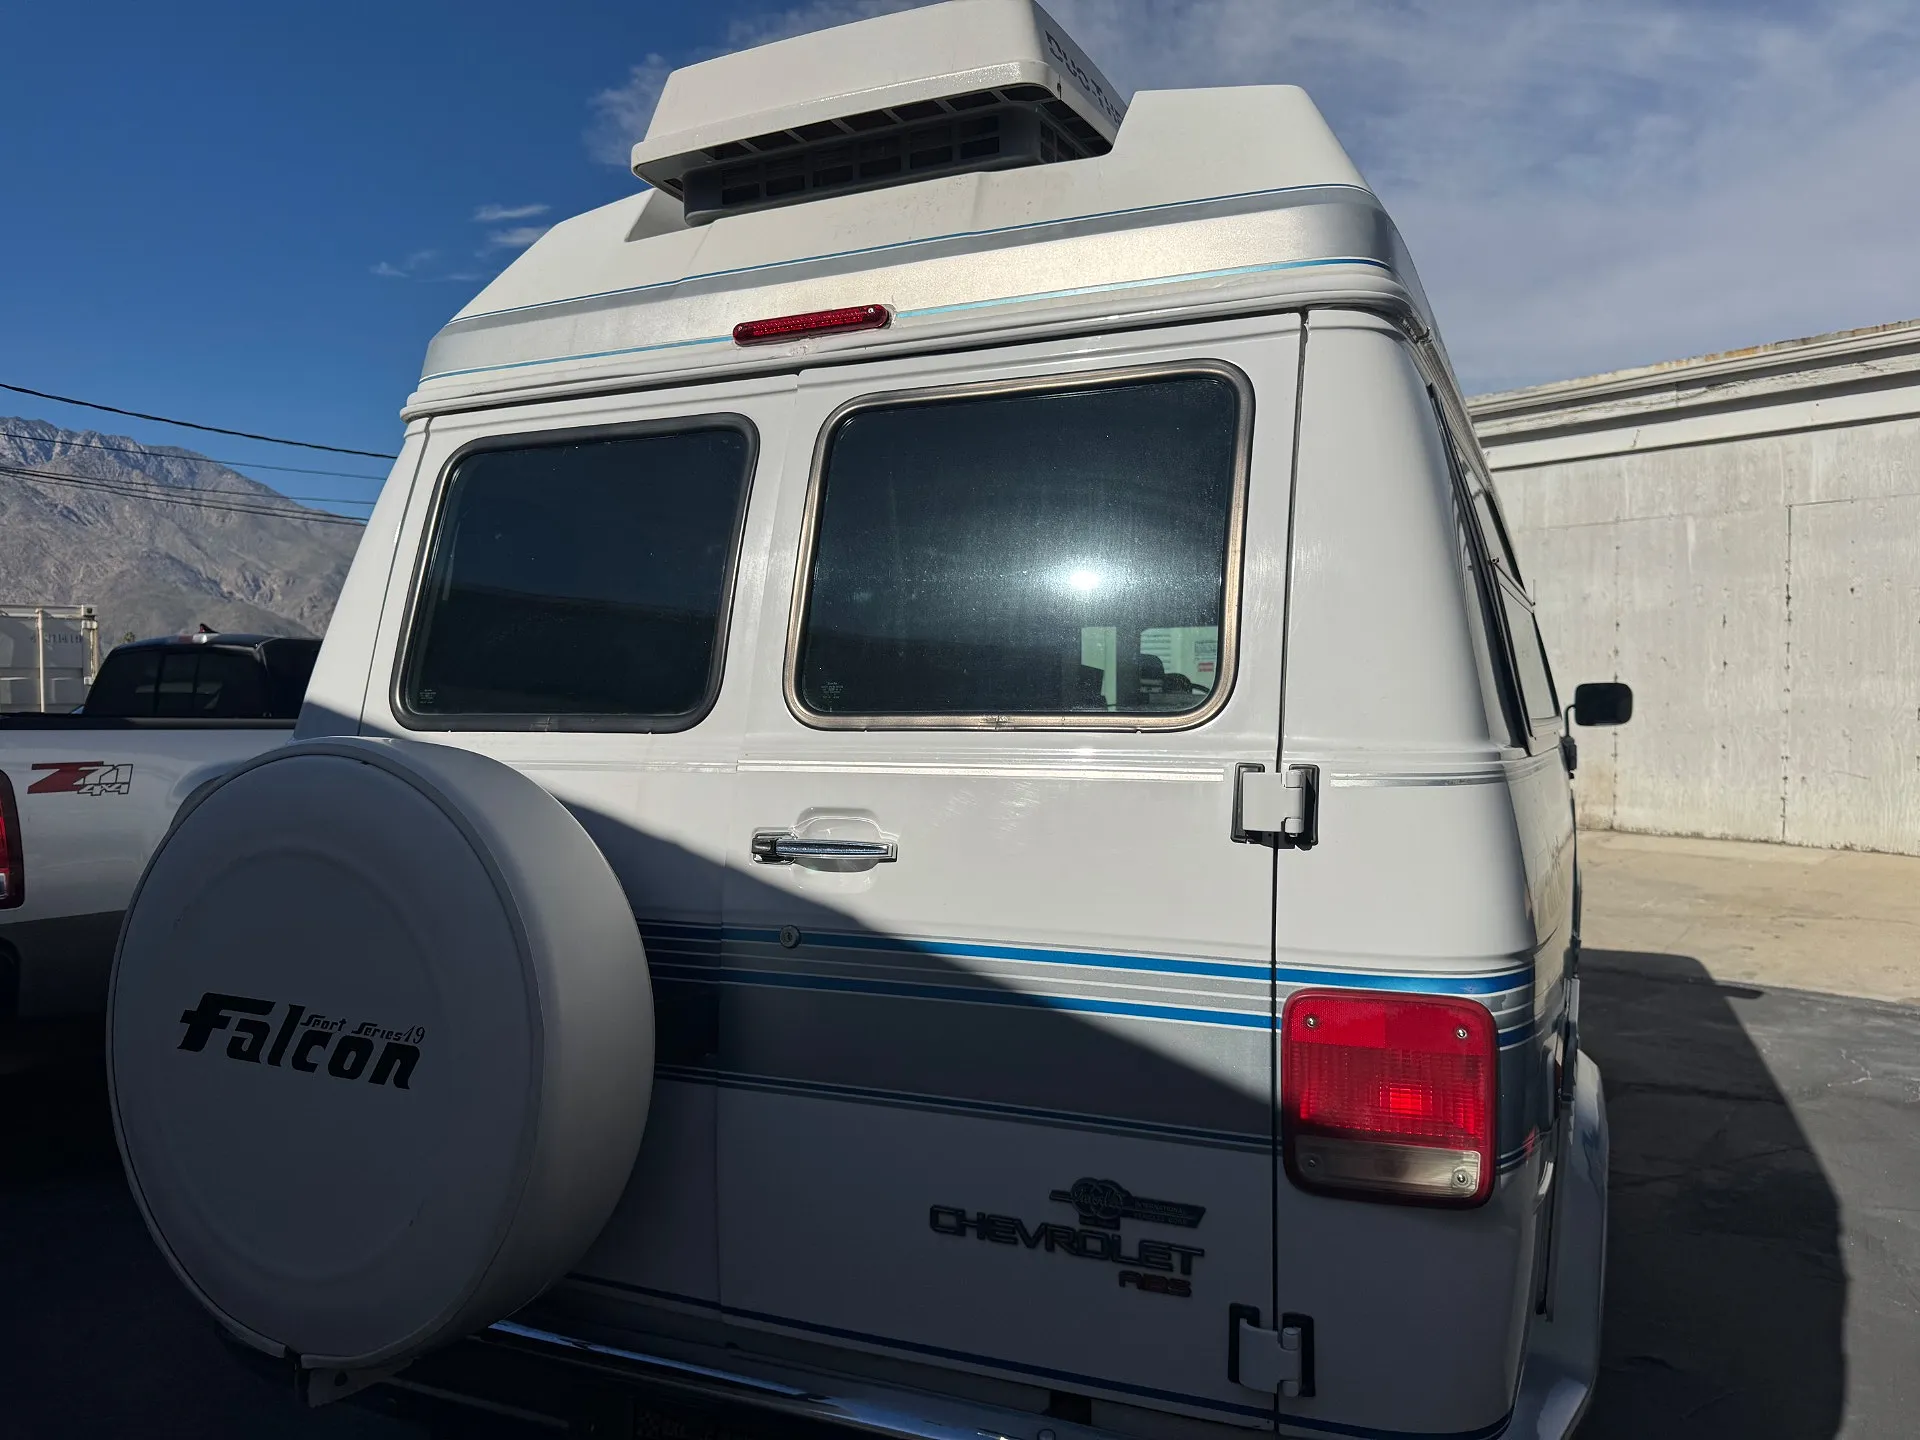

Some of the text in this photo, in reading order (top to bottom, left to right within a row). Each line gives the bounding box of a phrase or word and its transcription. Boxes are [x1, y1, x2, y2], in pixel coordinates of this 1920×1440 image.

[27, 761, 133, 794] Z71
[300, 1014, 347, 1031] Sport
[177, 992, 421, 1090] Falcon
[929, 1204, 1205, 1276] CHEVROLET
[1118, 1270, 1193, 1298] ABS
